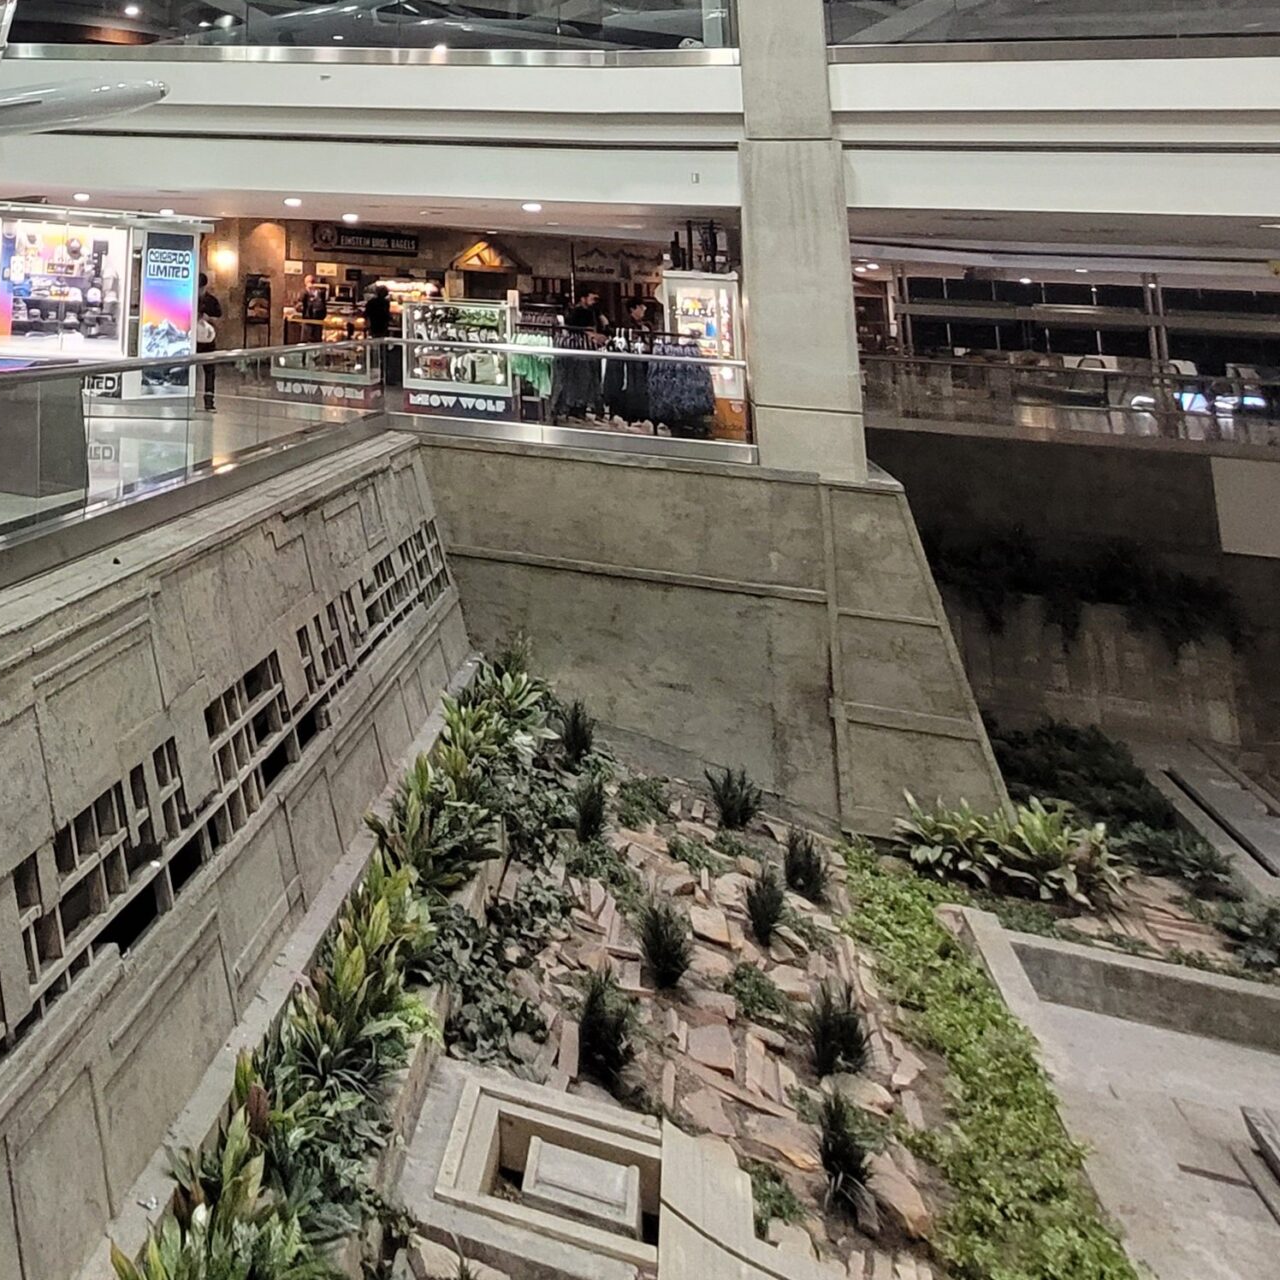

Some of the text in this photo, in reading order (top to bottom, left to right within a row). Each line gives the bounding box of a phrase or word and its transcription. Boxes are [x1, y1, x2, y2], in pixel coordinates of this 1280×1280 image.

[340, 235, 371, 247] EINSTEIN
[390, 239, 416, 250] BAGELS
[148, 250, 191, 265] COLORADO
[148, 264, 190, 279] LIMITED
[409, 392, 505, 412] MEOW WOLF
